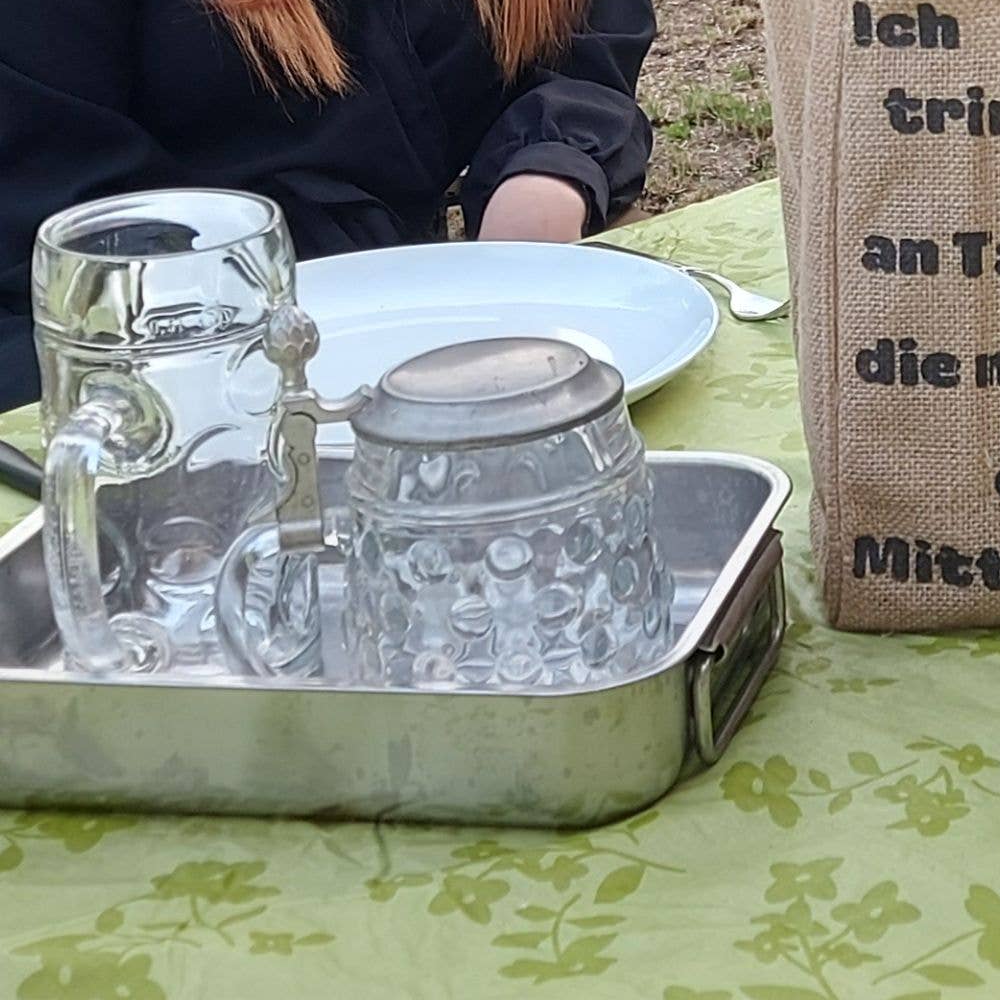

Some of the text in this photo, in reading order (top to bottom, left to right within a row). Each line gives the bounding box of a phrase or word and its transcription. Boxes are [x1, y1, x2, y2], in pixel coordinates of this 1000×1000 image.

[853, 1, 960, 50] Ich
[861, 234, 940, 276] an
[855, 337, 961, 389] die
